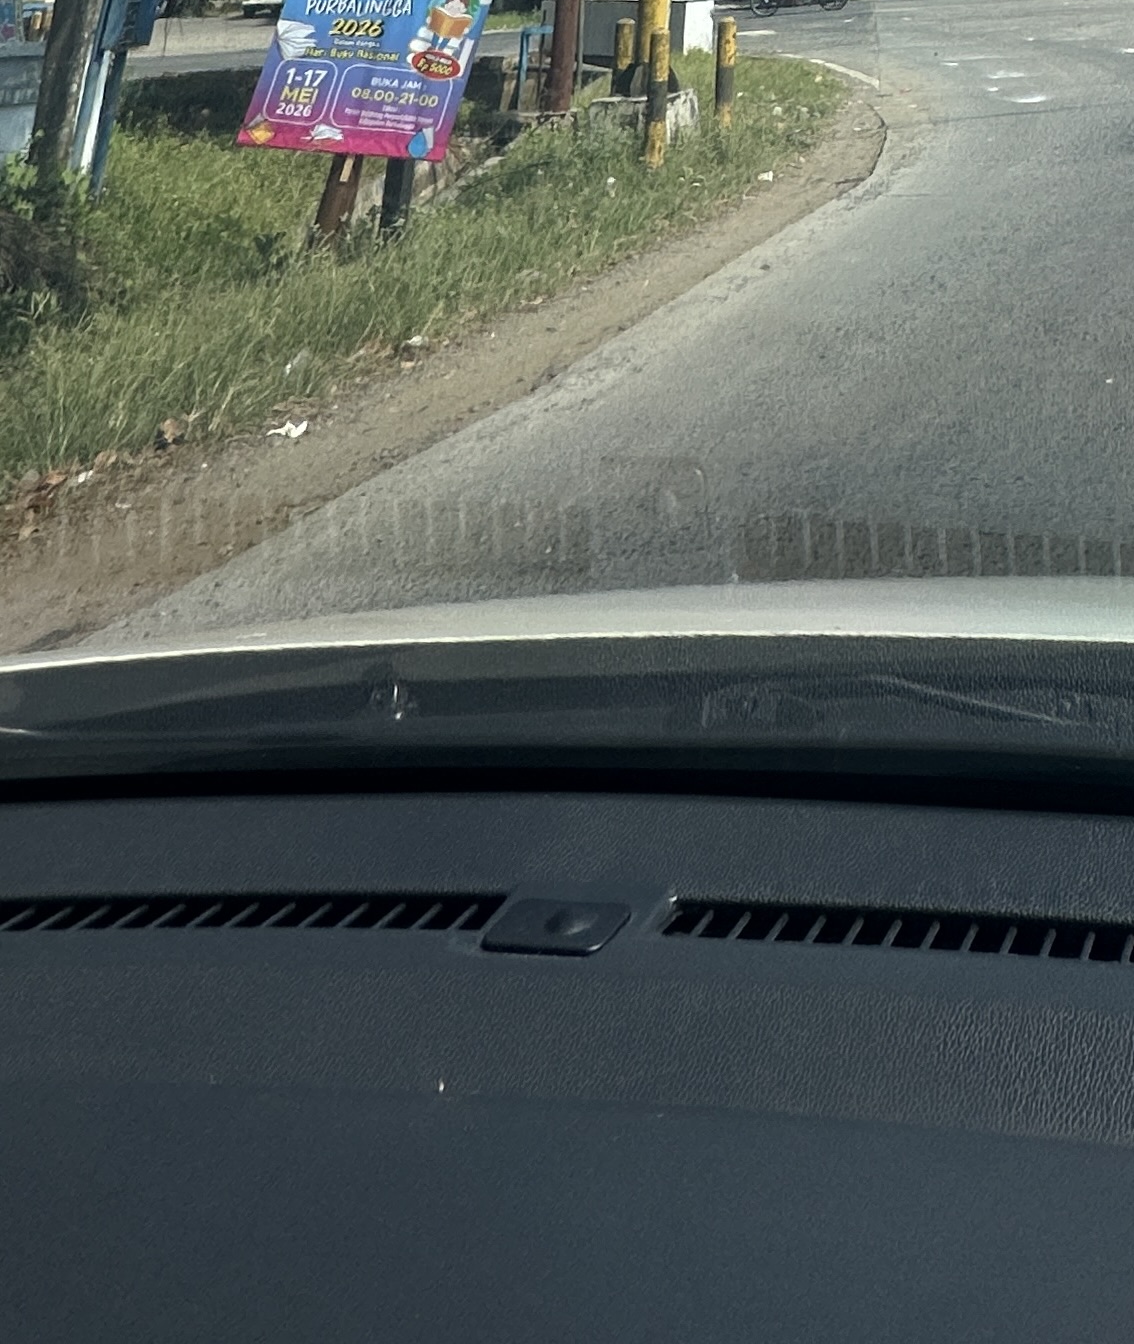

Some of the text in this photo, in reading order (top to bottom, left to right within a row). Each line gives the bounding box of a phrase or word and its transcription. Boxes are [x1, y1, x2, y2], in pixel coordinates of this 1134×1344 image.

[330, 19, 383, 38] 2026
[286, 67, 328, 88] 1-17
[371, 76, 399, 88] BUKA
[401, 80, 422, 90] JAM
[281, 86, 319, 105] MEI
[276, 103, 312, 118] 2026
